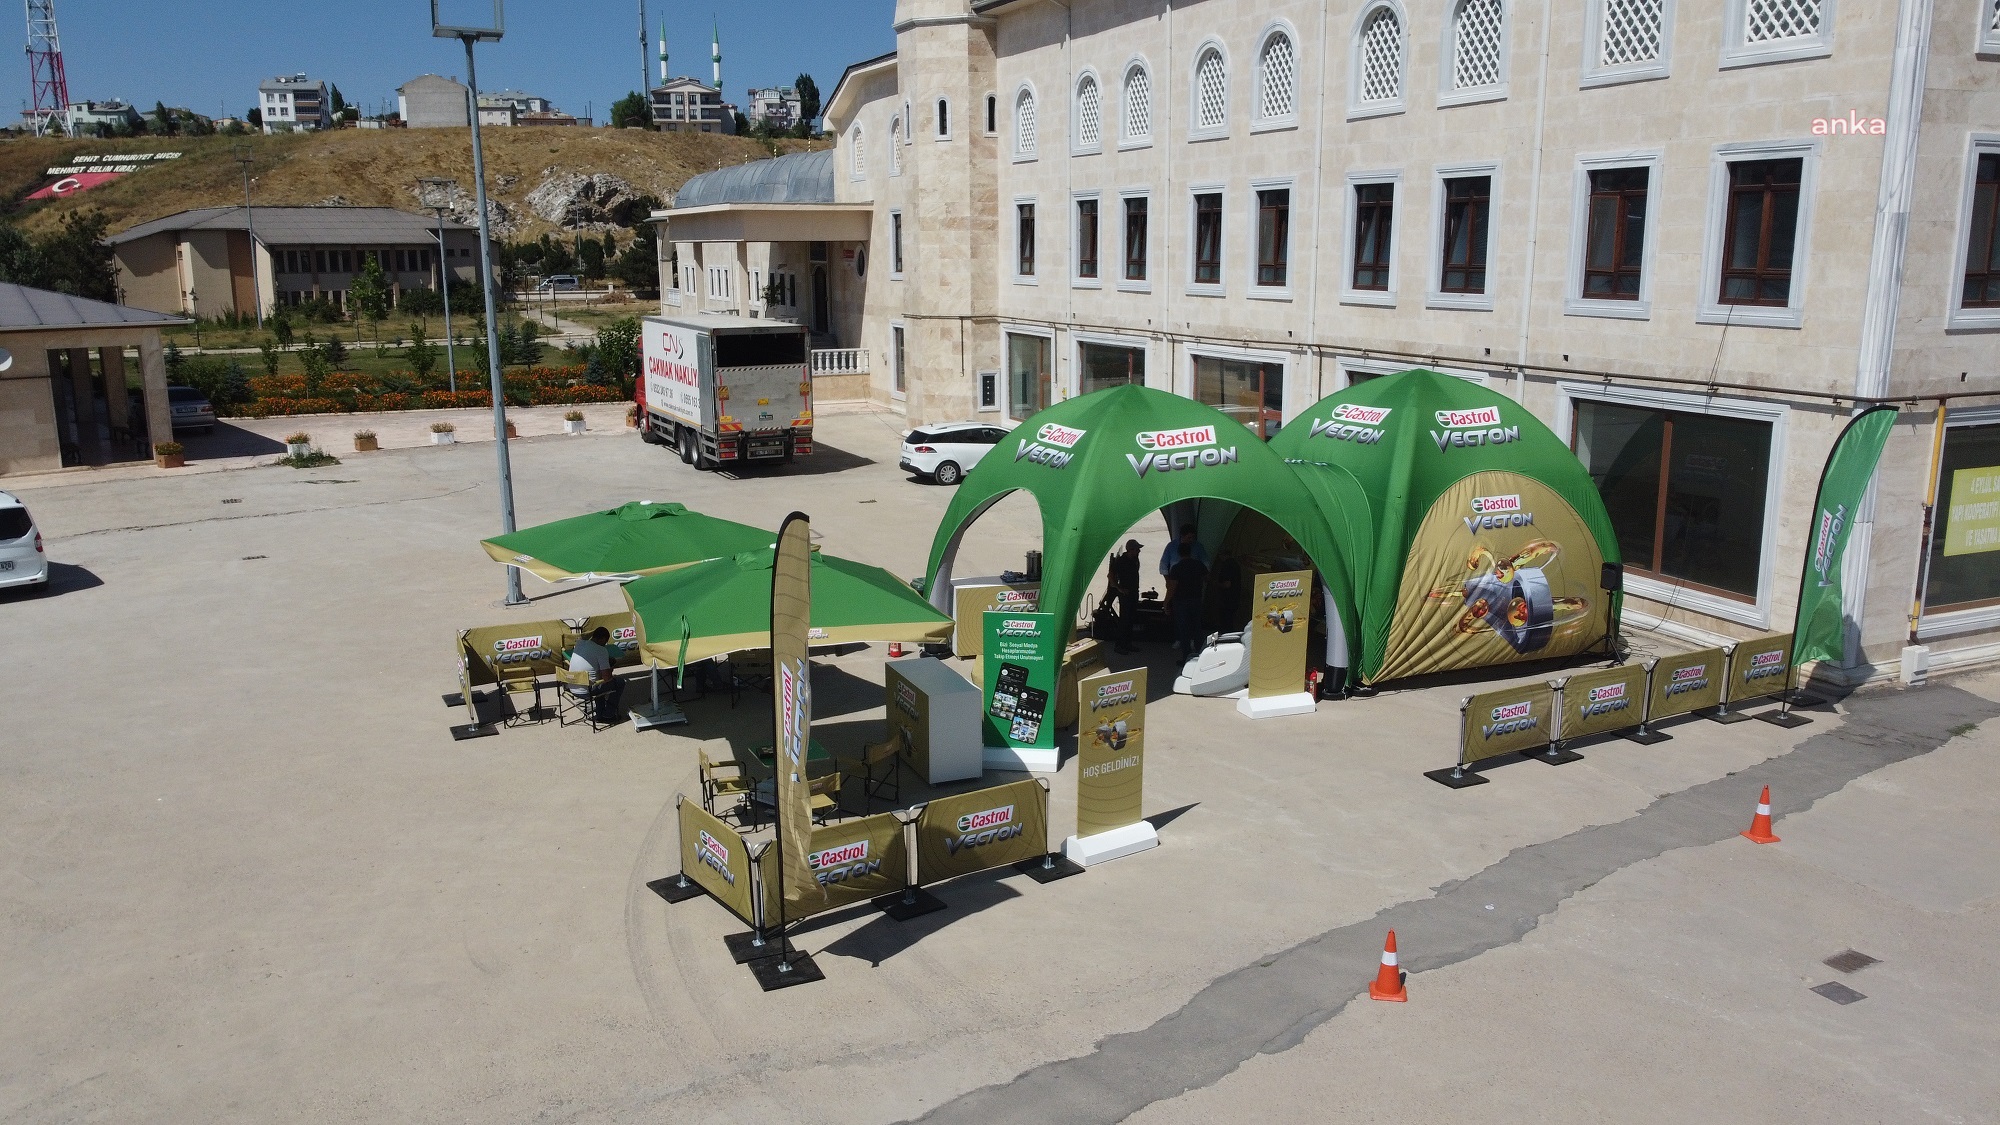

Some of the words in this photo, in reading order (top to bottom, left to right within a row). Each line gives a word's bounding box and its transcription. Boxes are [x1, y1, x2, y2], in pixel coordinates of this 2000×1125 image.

[46, 166, 87, 175] MEHMET
[648, 356, 673, 380] ÇAKMAK
[1345, 407, 1387, 422] Castrol
[1450, 409, 1497, 425] Castrol
[1047, 427, 1082, 445] Castrol
[1156, 429, 1213, 447] Castrol
[1309, 418, 1385, 445] VECTON
[1430, 426, 1520, 454] VECTON
[1014, 438, 1075, 469] VECTON
[1125, 446, 1238, 479] VECTON
[1484, 497, 1518, 511] Castrol
[1463, 512, 1533, 535] VECTON
[1817, 515, 1831, 558] Castrol
[1262, 588, 1303, 601] VECTON
[1275, 580, 1297, 589] Castrol
[1007, 590, 1037, 601] Castrol
[996, 629, 1041, 638] VECTON
[1010, 621, 1034, 629] Castrol
[506, 637, 539, 650] Castrol
[1757, 652, 1781, 664] Castrol
[1679, 667, 1702, 679] Castrol
[1744, 664, 1786, 685] VECTON
[1105, 682, 1131, 695] Castrol
[1597, 684, 1623, 699] Castrol
[1664, 678, 1708, 700] VECTON
[782, 669, 792, 736] Castrol
[1090, 692, 1138, 713] VECTON
[1501, 703, 1528, 719] Castrol
[1580, 697, 1630, 720] VECTON
[1482, 716, 1538, 740] VECTON
[1083, 765, 1100, 778] HOŞ
[1101, 756, 1140, 775] GELDİNİZ!
[971, 807, 1010, 829] Castrol
[945, 822, 1023, 856] VECTON
[707, 836, 728, 864] Castrol
[821, 843, 865, 866] Castrol
[694, 842, 736, 887] VECTON
[816, 858, 881, 886] ECTON
